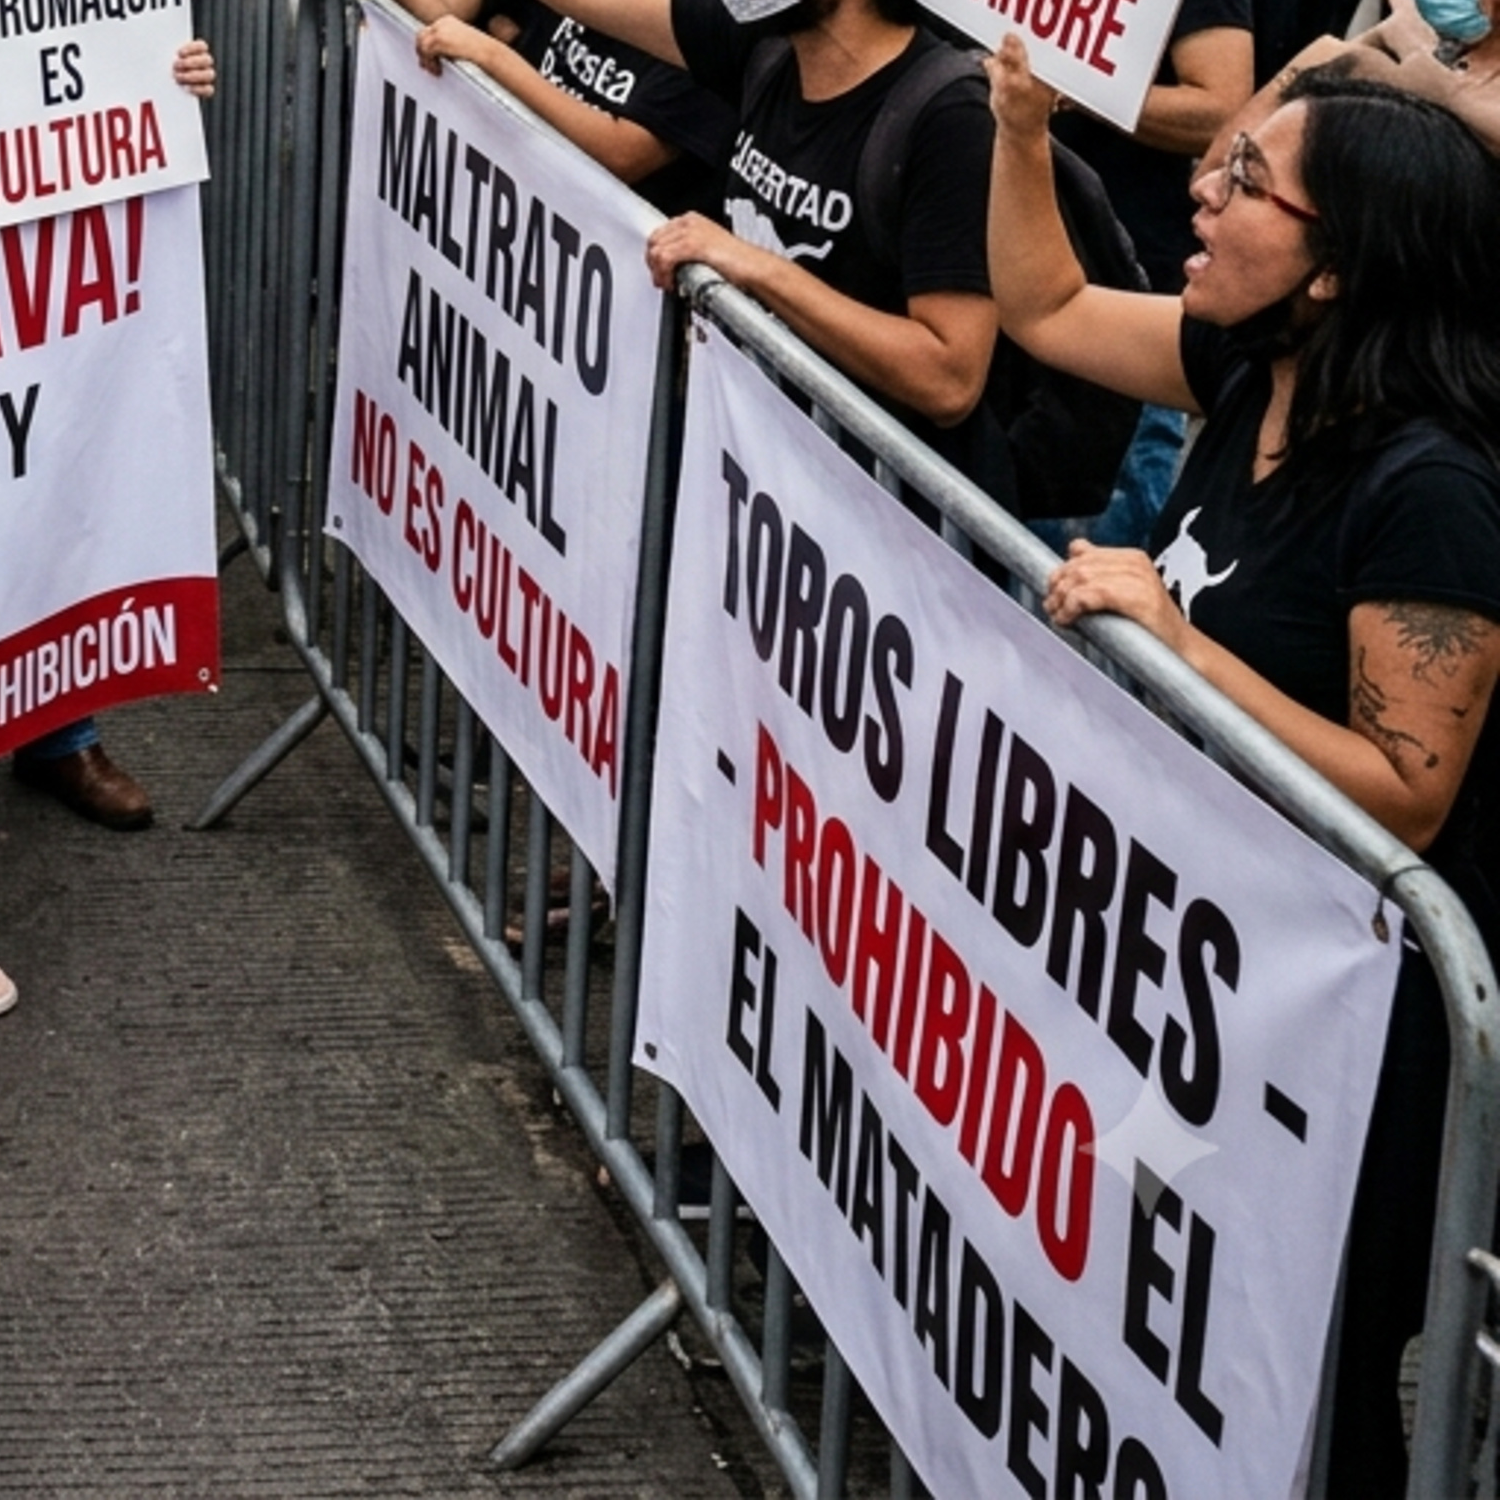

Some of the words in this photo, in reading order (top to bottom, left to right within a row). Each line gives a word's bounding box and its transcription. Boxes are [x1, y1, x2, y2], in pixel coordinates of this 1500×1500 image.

[40, 42, 85, 107] ES
[377, 78, 614, 396] MALTRATO
[397, 267, 568, 558] ANIMAL
[351, 389, 398, 517] NO
[404, 439, 443, 574] ES
[451, 497, 622, 800] CULTURA
[721, 448, 915, 803] TOROS
[924, 669, 1241, 1127] LIBRES
[726, 904, 782, 1115] EL
[751, 719, 1096, 1283] PROHIBIDO
[1122, 1156, 1225, 1451] EL
